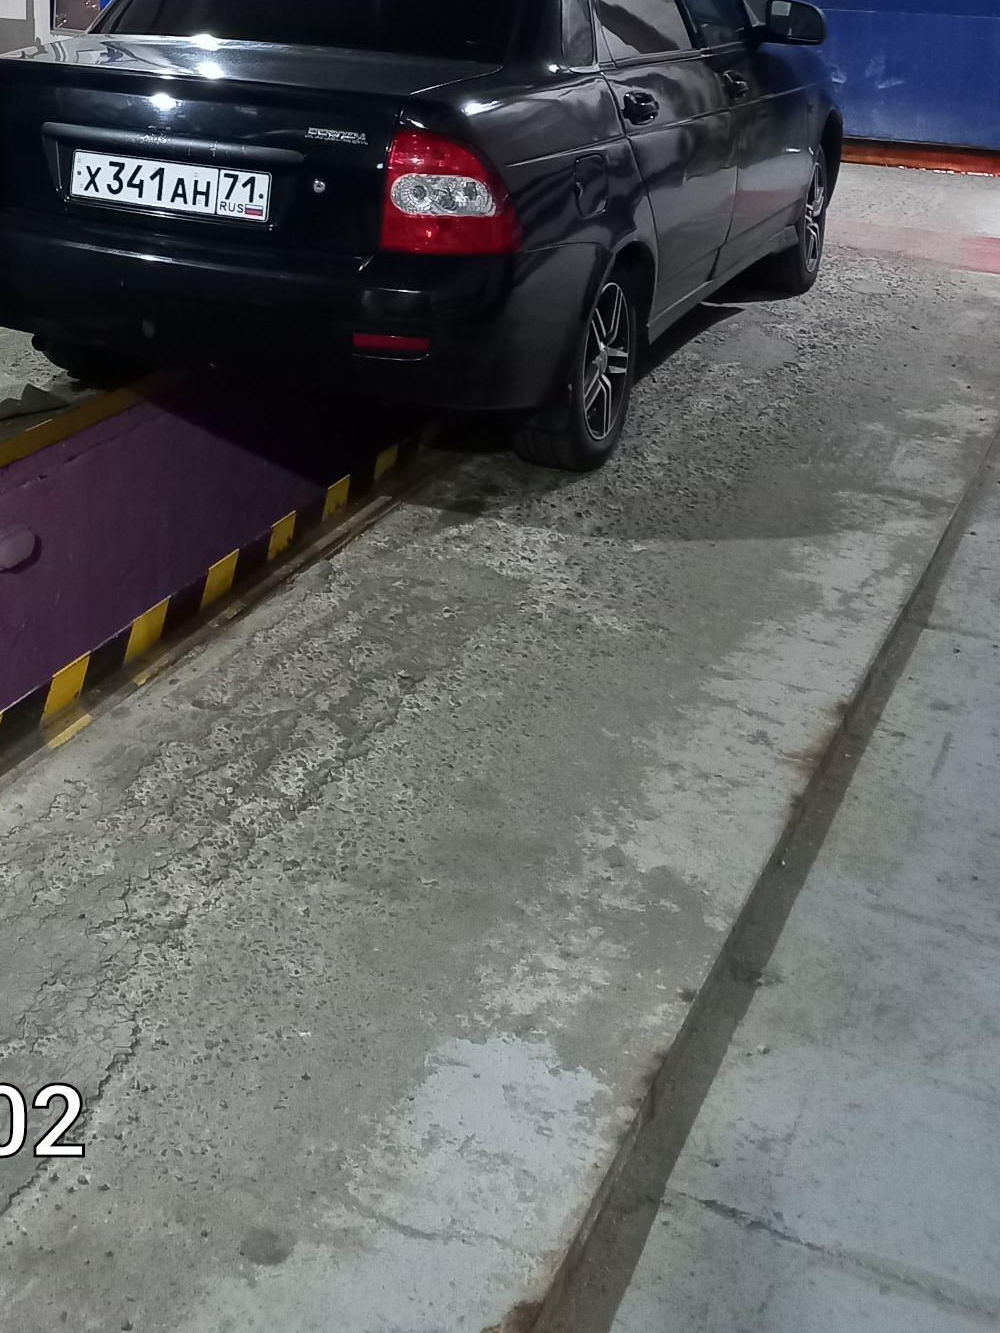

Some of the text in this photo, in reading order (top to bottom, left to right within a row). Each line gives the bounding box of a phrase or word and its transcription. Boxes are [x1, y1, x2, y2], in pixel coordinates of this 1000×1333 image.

[83, 161, 255, 208] Х341АН 71
[219, 201, 244, 214] RUS
